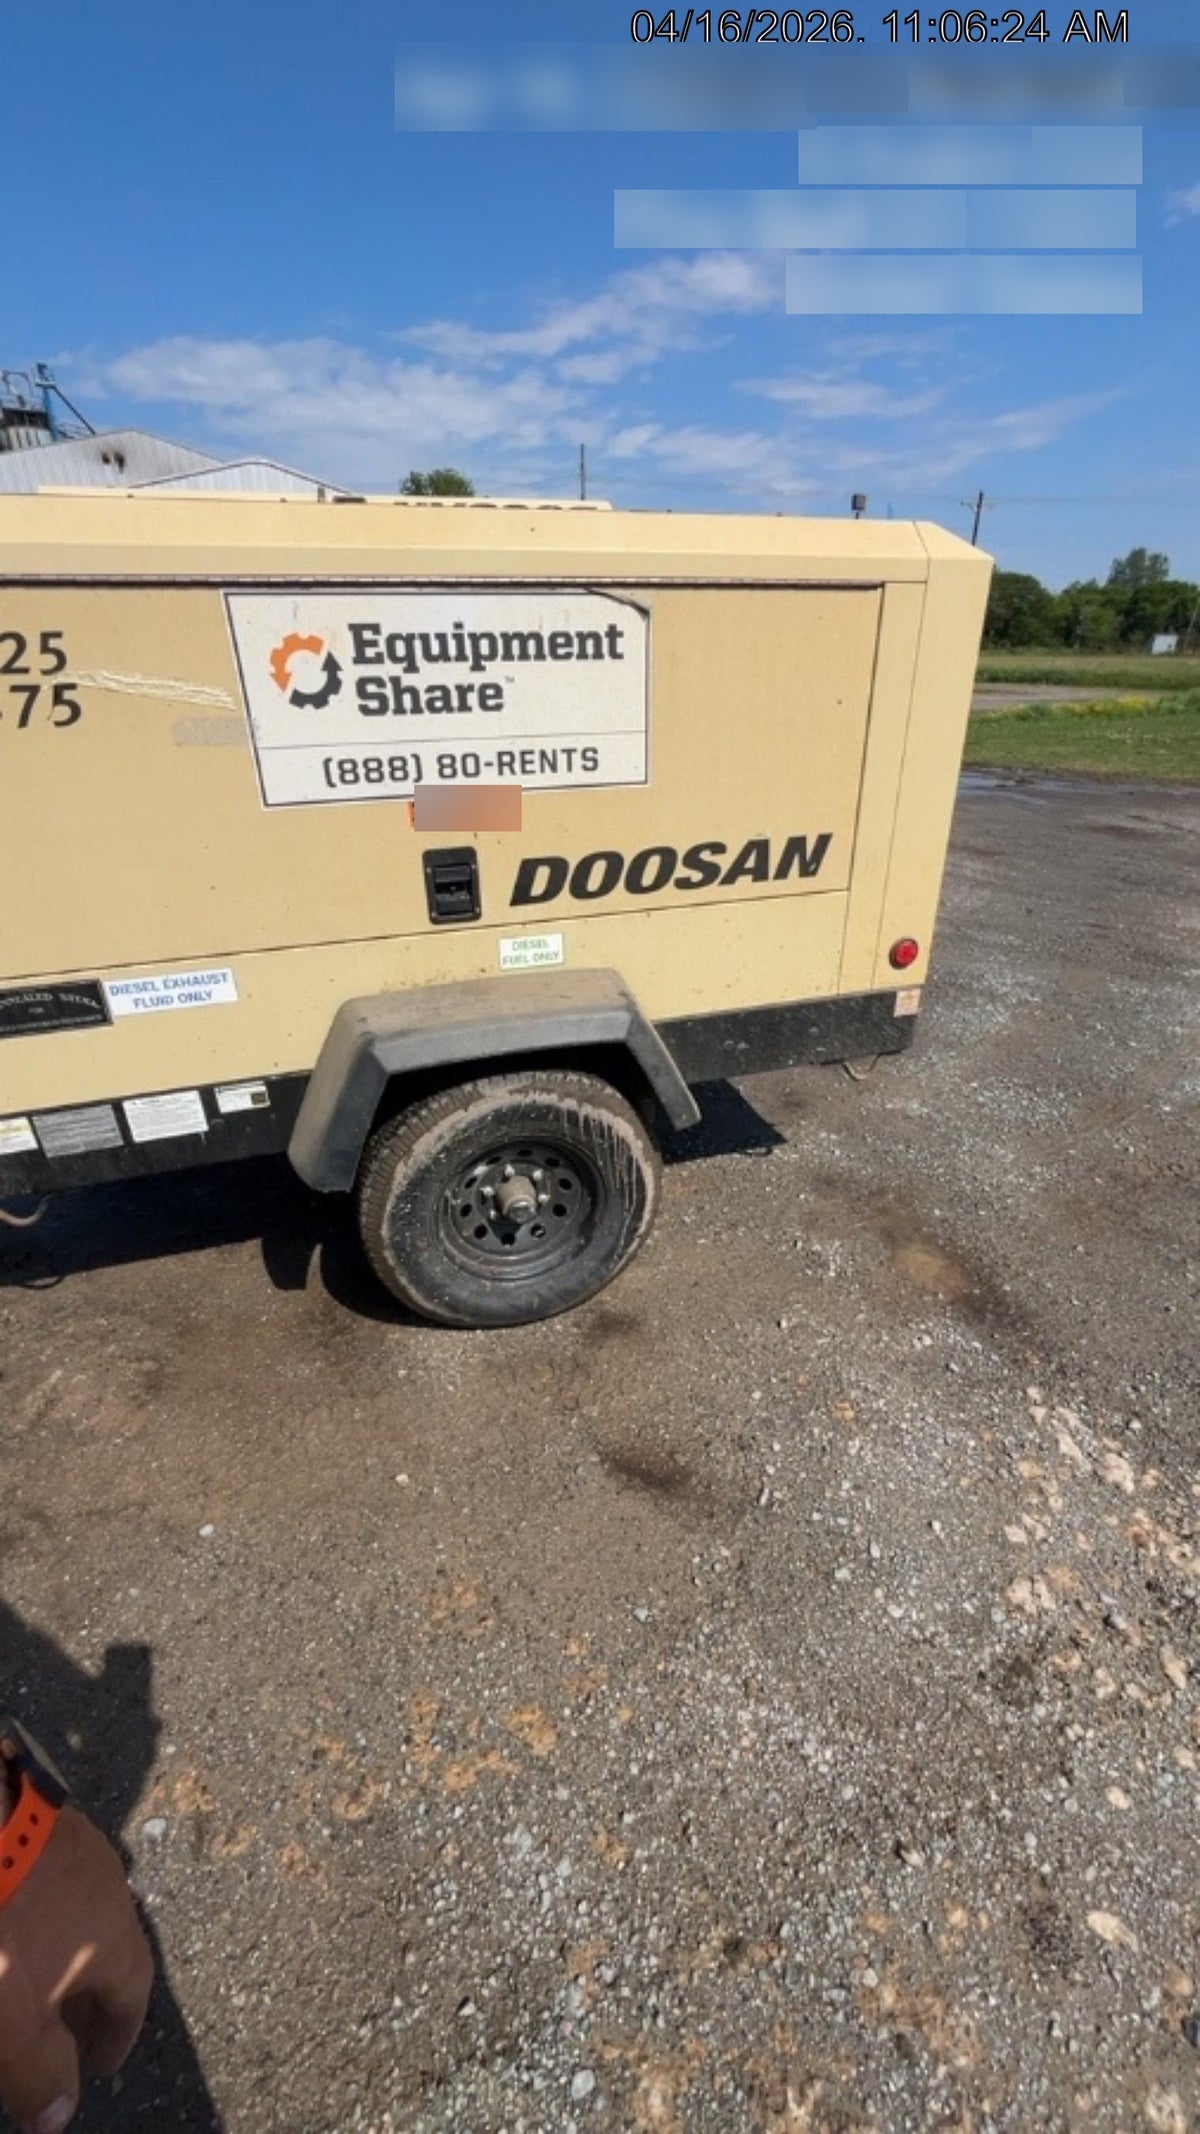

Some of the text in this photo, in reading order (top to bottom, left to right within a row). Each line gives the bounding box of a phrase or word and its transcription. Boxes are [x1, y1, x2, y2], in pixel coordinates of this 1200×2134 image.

[348, 622, 625, 673] Equipment
[0, 683, 81, 729] 75
[355, 676, 504, 716] Share
[323, 747, 600, 787] (888) 80-RENTS
[510, 833, 833, 906] DOOSAN
[109, 972, 228, 996] DIESEL EXHAUST
[133, 990, 212, 1009] FLUID ONLY
